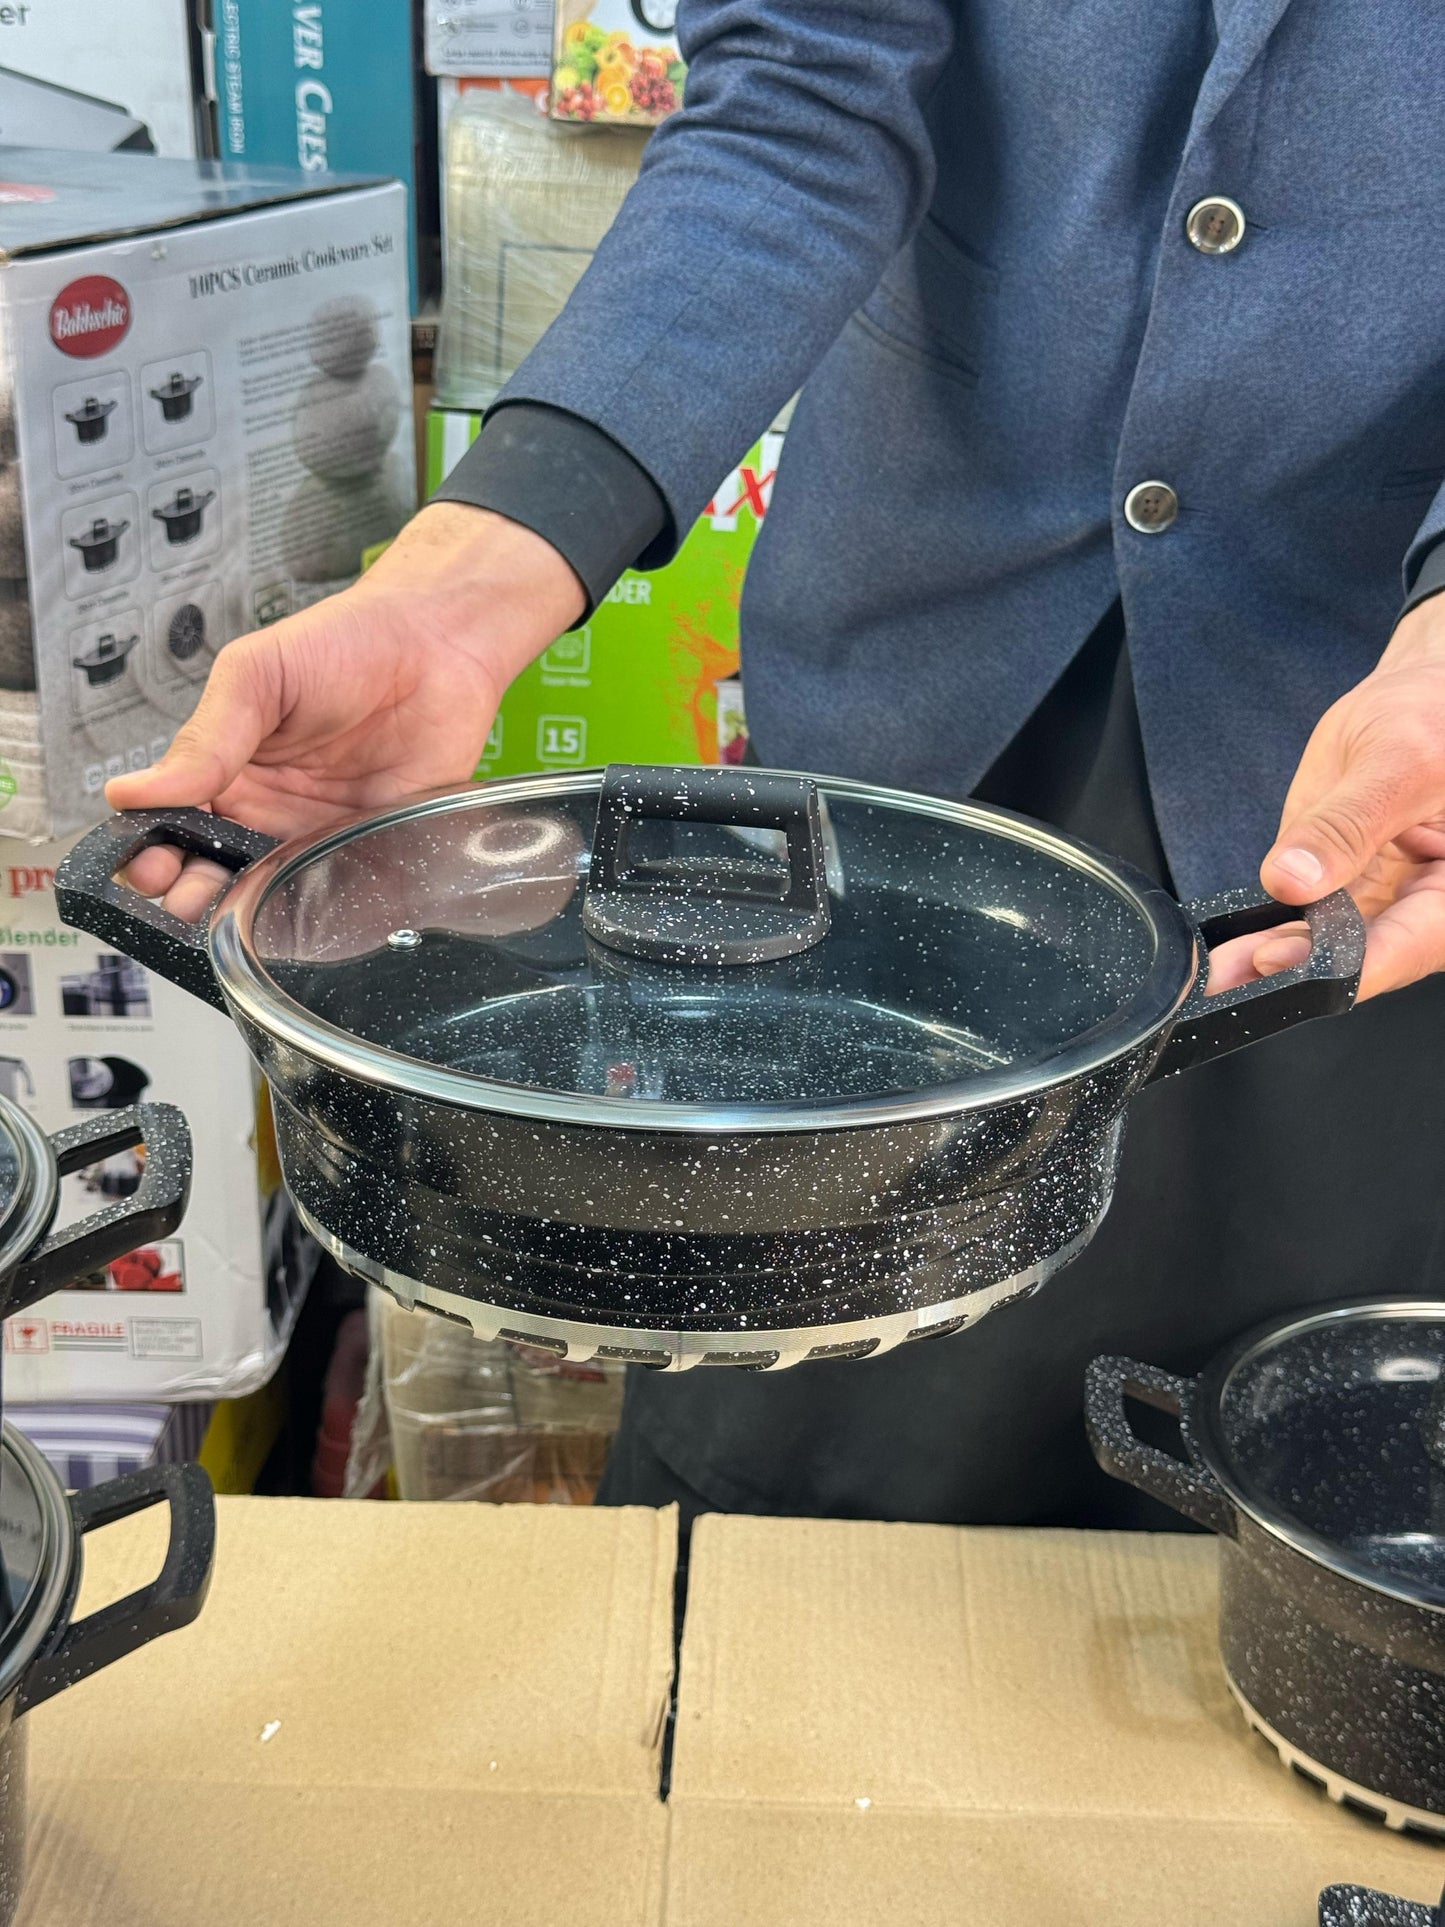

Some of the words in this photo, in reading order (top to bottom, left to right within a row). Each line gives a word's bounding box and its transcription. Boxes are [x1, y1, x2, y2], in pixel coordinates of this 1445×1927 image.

[292, 0, 324, 70] VER
[225, 60, 243, 114] STEAM
[229, 115, 246, 154] IRON
[242, 256, 301, 287] Ceramic
[301, 241, 370, 272] Cookware
[544, 728, 579, 753] 15
[0, 926, 79, 946] lender
[52, 1321, 125, 1336] FRAGILE
